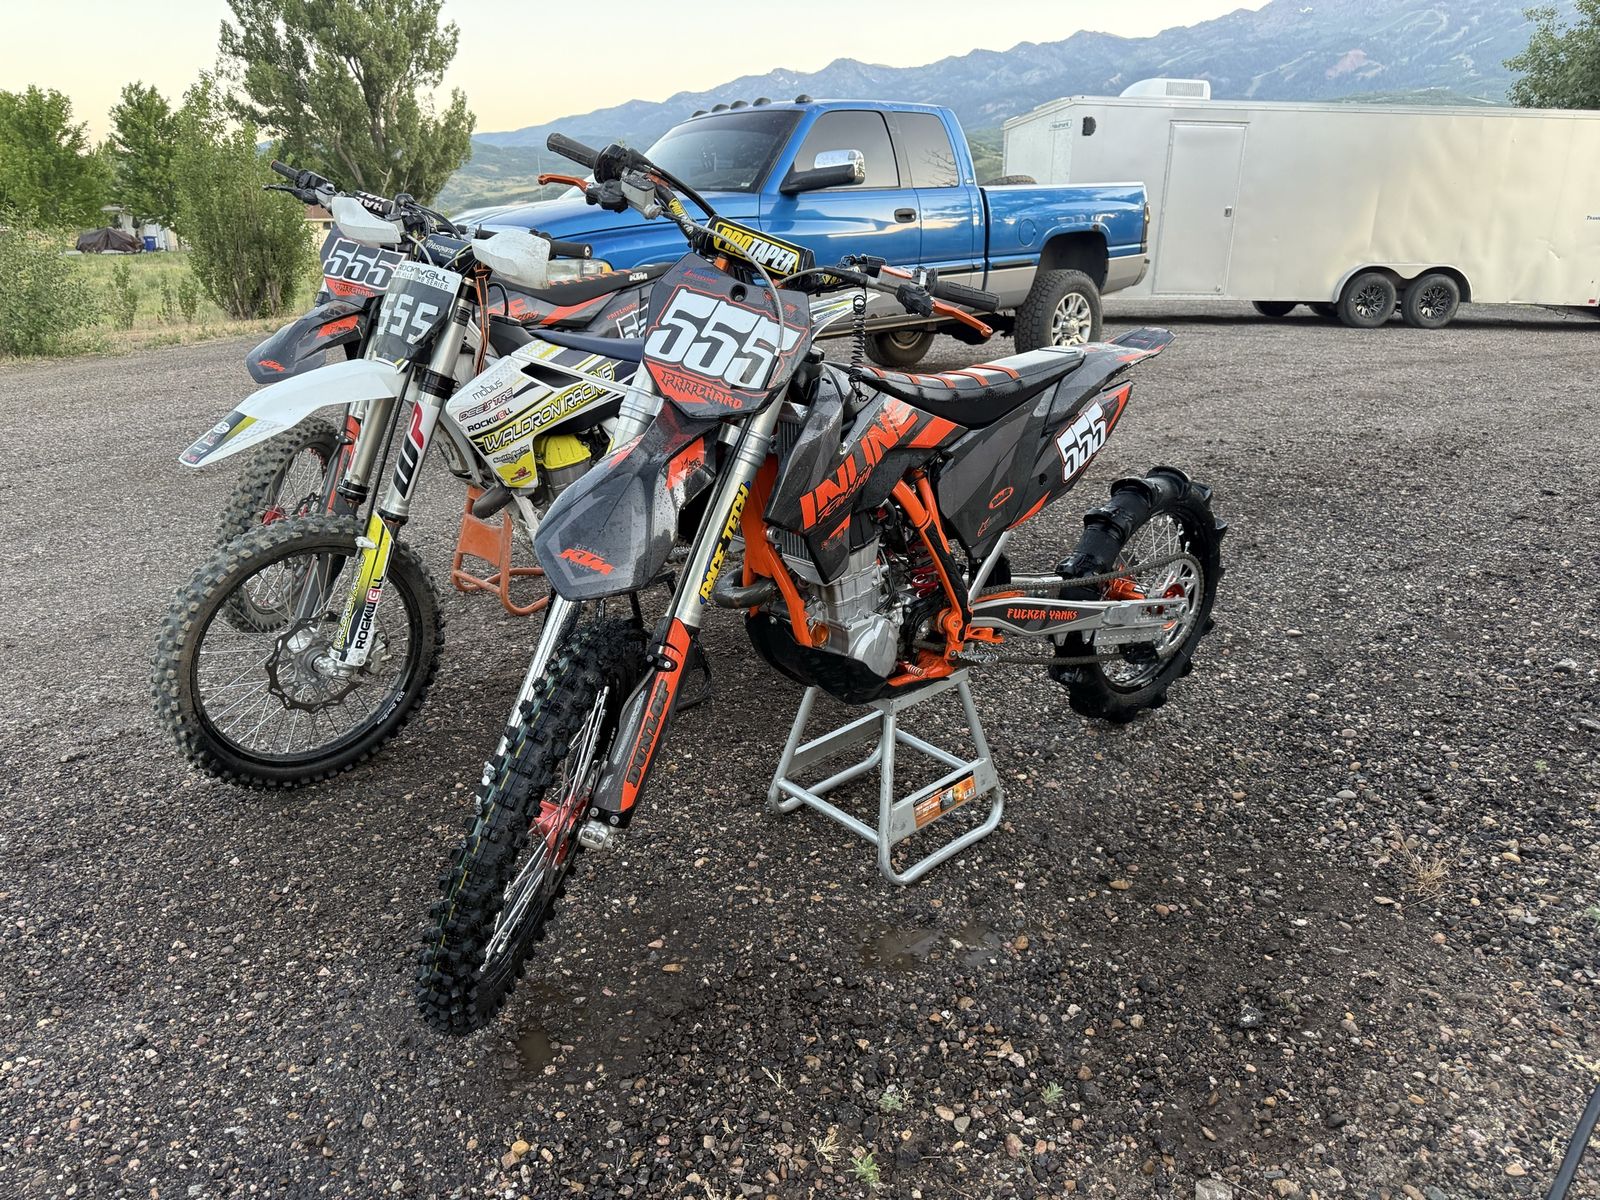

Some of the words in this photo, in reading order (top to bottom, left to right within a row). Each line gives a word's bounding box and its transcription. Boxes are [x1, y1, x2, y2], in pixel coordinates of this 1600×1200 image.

[323, 238, 407, 290] 555
[719, 226, 798, 273] PROTAPER
[629, 272, 648, 281] KTM
[645, 288, 801, 390] 555
[660, 369, 744, 409] PRITCHARD
[467, 407, 513, 433] ROCKWELL
[484, 398, 562, 452] WALDRON
[1056, 401, 1107, 481] 555
[557, 548, 615, 576] KTM
[699, 541, 728, 601] RACE
[722, 482, 750, 541] TECH
[1006, 607, 1046, 620] FUCKER
[1049, 609, 1078, 621] YANKS
[626, 679, 669, 787] DUNLOP
